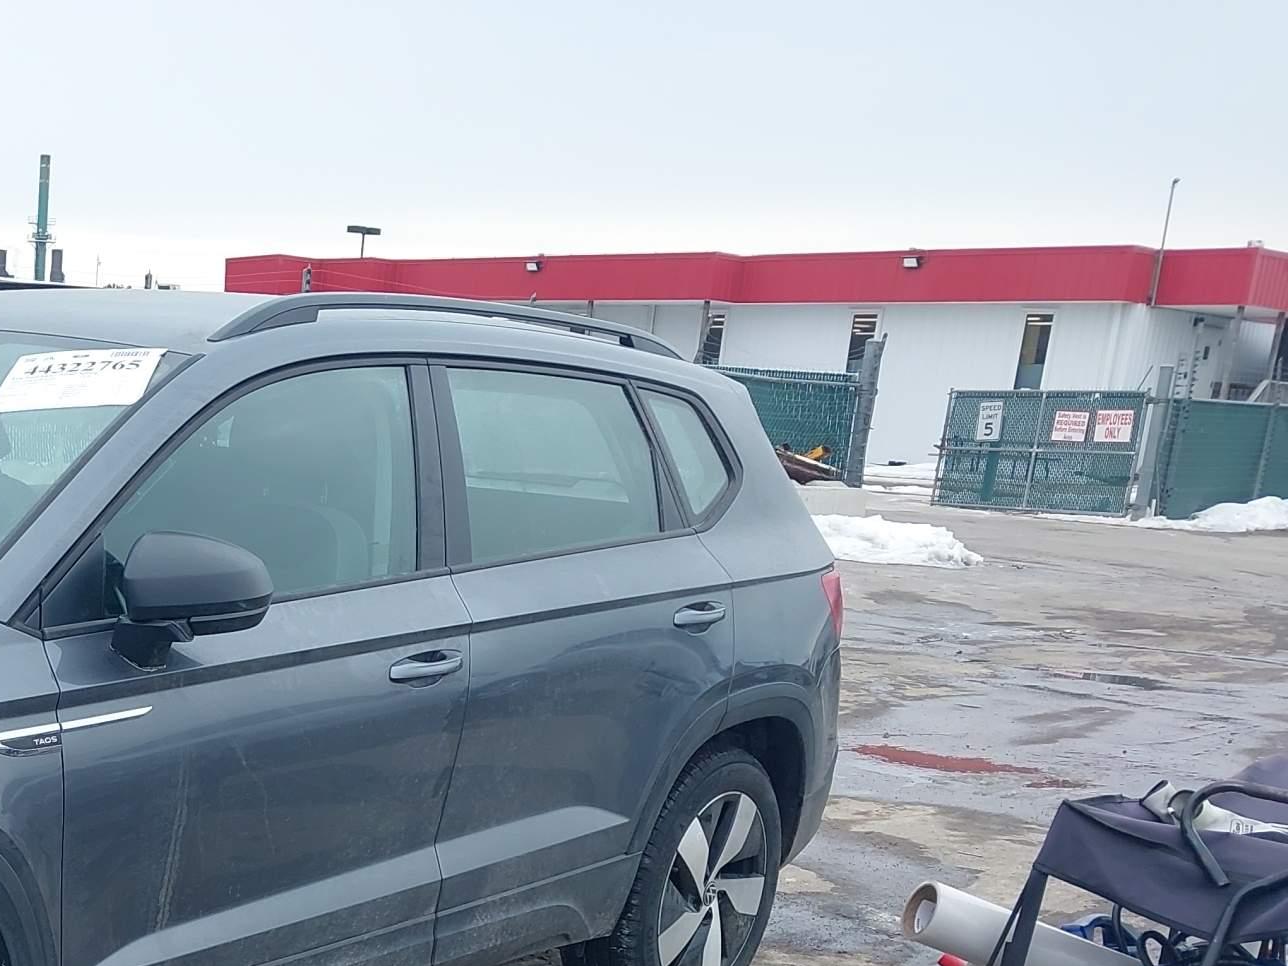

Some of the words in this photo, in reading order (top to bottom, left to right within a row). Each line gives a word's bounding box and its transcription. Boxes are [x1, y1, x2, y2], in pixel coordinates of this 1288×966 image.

[24, 359, 143, 376] 44322765
[1097, 413, 1132, 425] EMPLOYEES
[983, 422, 993, 436] 5
[1104, 427, 1122, 439] ONLY
[33, 735, 58, 746] TAOS
